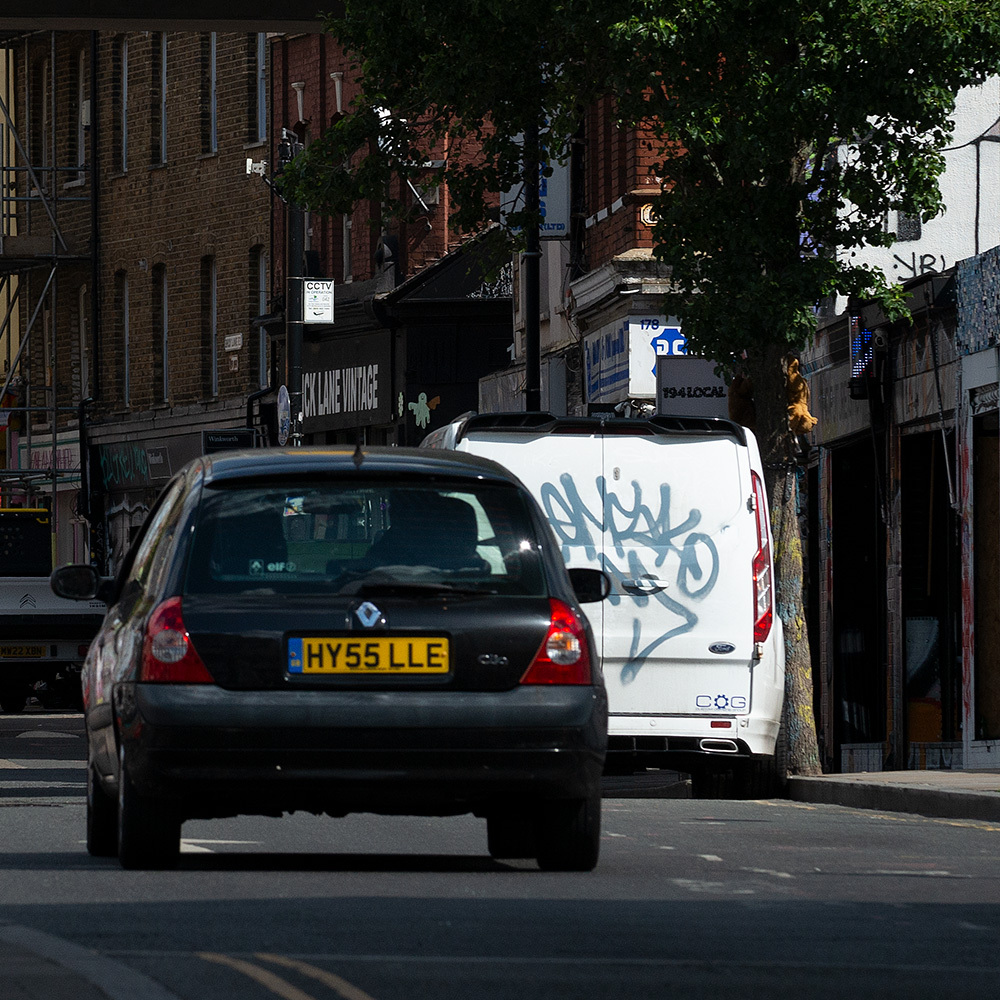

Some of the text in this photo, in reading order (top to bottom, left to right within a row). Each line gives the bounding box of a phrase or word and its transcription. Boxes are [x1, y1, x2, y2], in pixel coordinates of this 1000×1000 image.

[306, 282, 332, 291] CCTV
[640, 319, 660, 330] 178
[318, 369, 340, 416] LANE
[342, 364, 379, 413] VINTAGE
[307, 643, 442, 668] HY55 LLE
